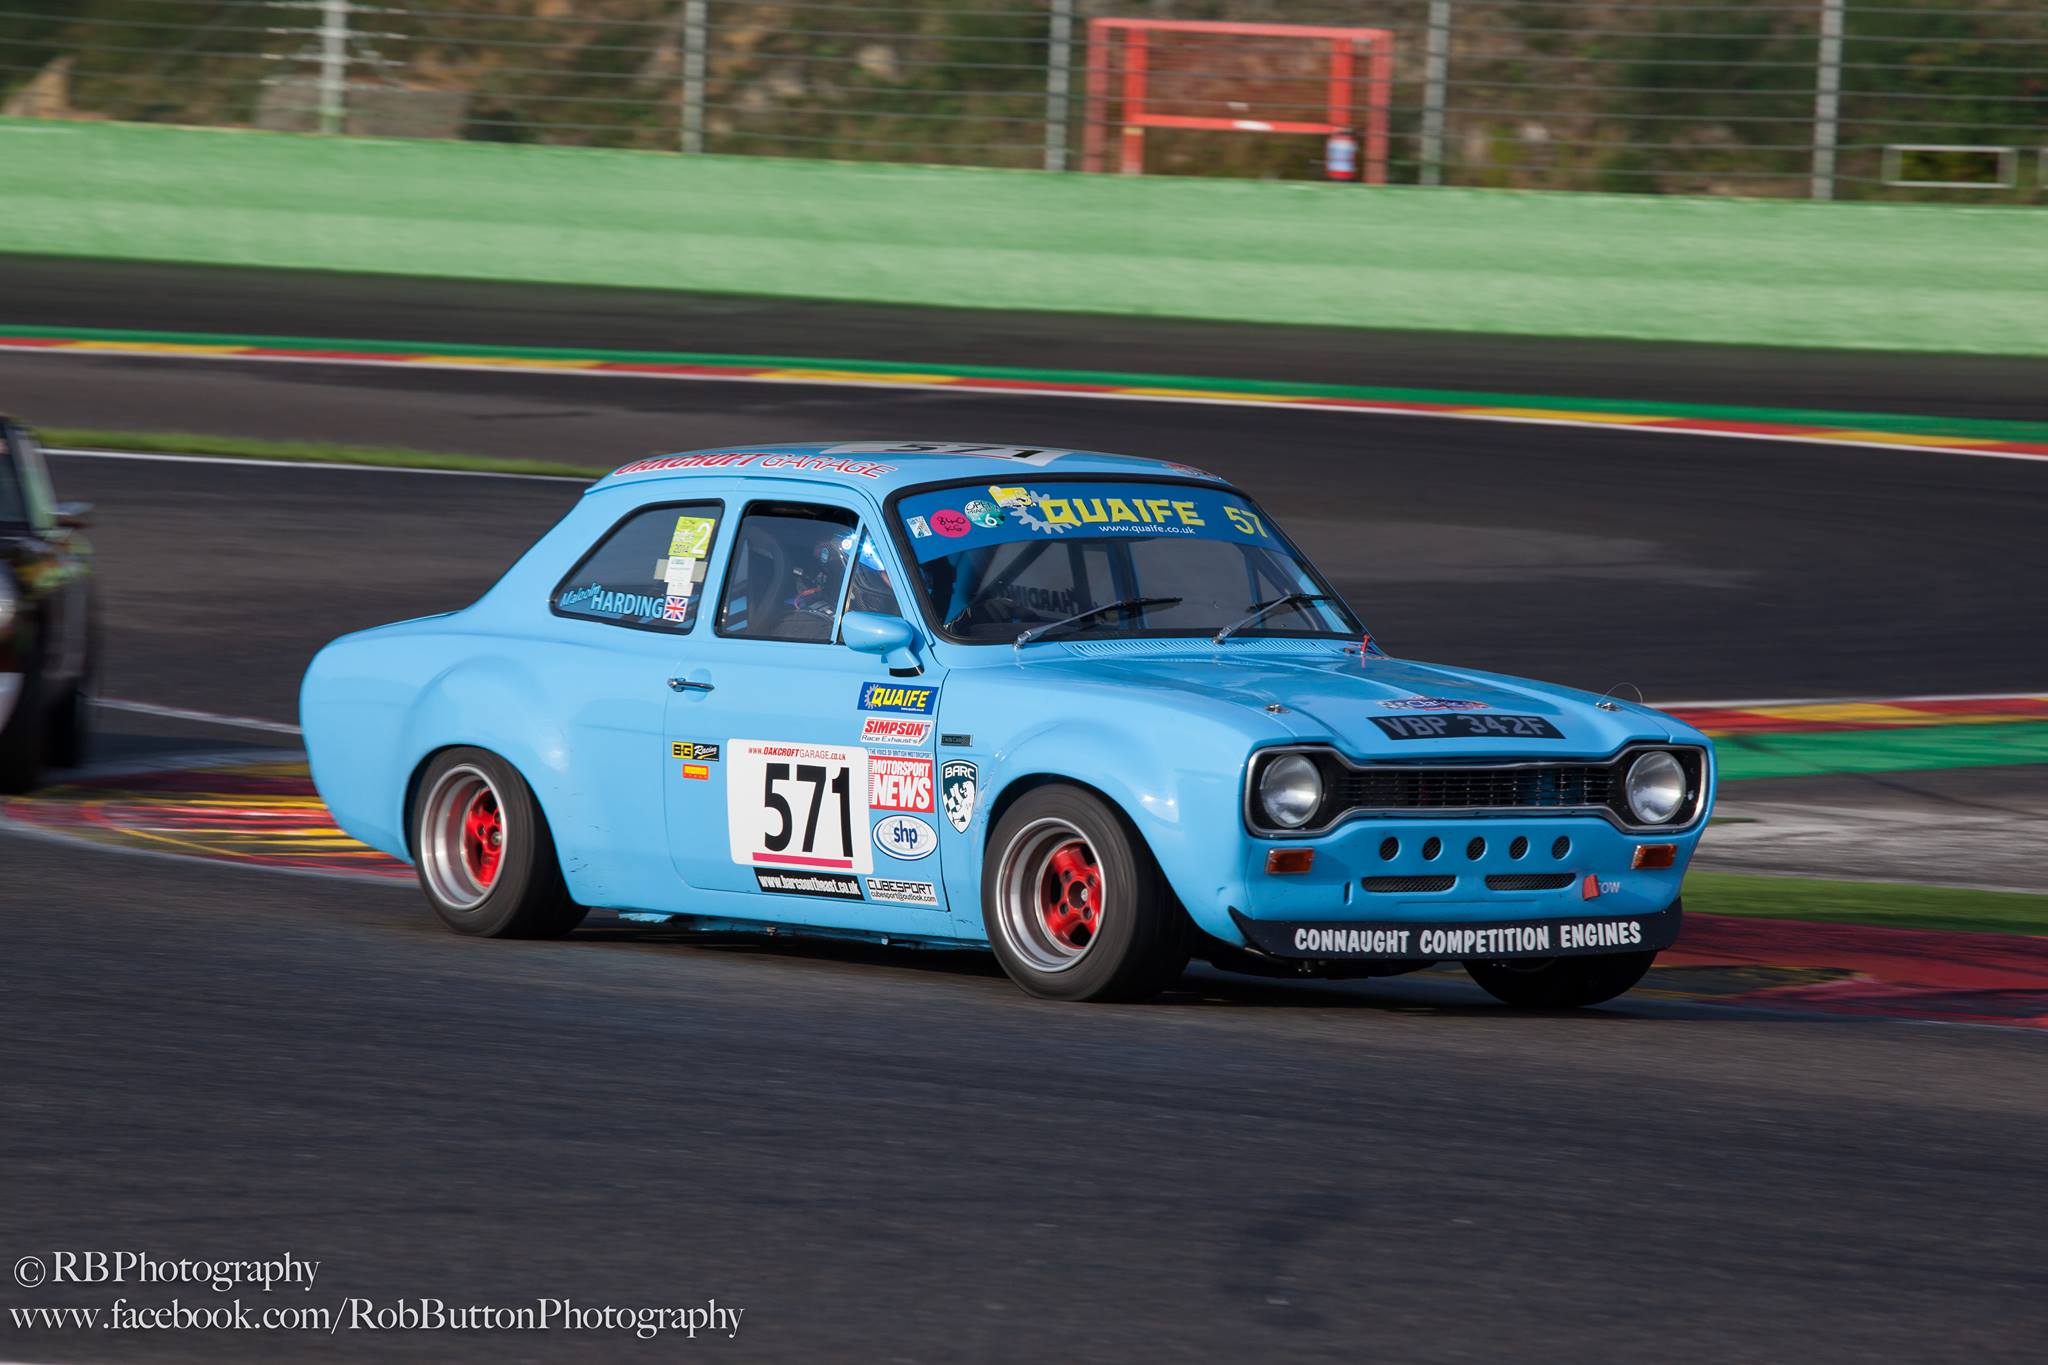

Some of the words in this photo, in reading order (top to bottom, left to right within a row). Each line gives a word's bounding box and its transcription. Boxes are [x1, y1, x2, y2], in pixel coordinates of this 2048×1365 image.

[886, 444, 1045, 459] 571
[614, 453, 765, 476] OAKCROFT
[762, 453, 897, 479] GARAGE
[1040, 498, 1205, 526] QUAIFE
[691, 522, 711, 555] 2
[1099, 525, 1196, 534] www.quaife.co.uk
[590, 591, 665, 619] HARDING
[871, 687, 930, 708] QUAIFE
[865, 720, 924, 736] SIMPSON
[1379, 716, 1448, 737] VBP
[1456, 715, 1546, 736] 342F
[861, 734, 880, 742] Race
[881, 736, 920, 744] Exhausts
[873, 760, 930, 777] MOTORSPORT
[945, 765, 974, 780] BARC
[873, 774, 931, 809] NEWS
[764, 763, 853, 857] 571
[894, 820, 918, 849] shp
[758, 875, 860, 896] www.barcsoutheast.co.uk
[867, 879, 932, 895] CUBESPORT
[871, 891, 936, 903] cubesport@outlook.com
[1295, 928, 1409, 953] CONNAUGHT
[1419, 926, 1550, 954] COMPETITION
[1560, 921, 1642, 949] ENGINES
